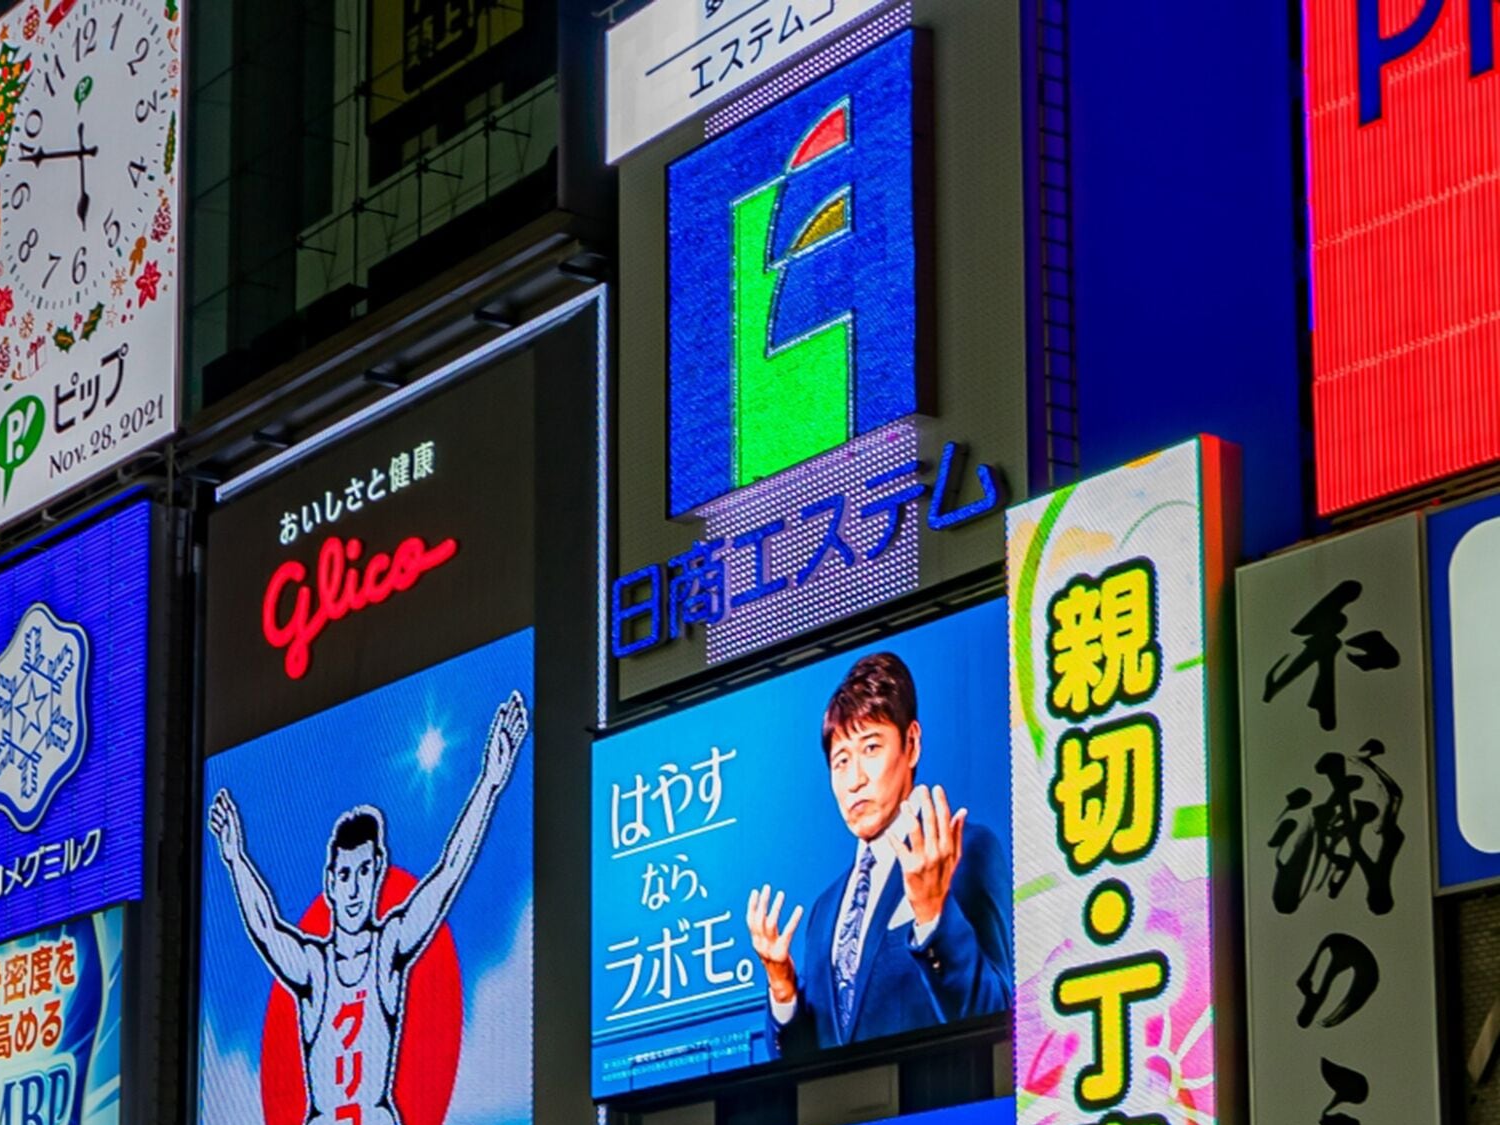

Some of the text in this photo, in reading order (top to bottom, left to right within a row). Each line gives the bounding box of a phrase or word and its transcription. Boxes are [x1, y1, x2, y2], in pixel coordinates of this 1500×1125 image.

[72, 19, 96, 60] 12
[110, 14, 123, 49] 1
[41, 57, 65, 96] 11
[127, 38, 150, 76] 2
[134, 91, 157, 122] 3
[128, 158, 146, 189] 4
[11, 182, 30, 210] 9
[19, 229, 38, 262] 8
[103, 210, 122, 249] 5
[41, 254, 62, 290] 7
[72, 247, 87, 285] 6
[53, 343, 129, 435] ピップ
[49, 396, 166, 476] Nov. 28, 2021
[279, 441, 435, 545] おいしさと健康
[610, 440, 998, 659] 日商エステム
[262, 536, 458, 679] Glico
[611, 746, 737, 849] はやす
[641, 854, 708, 910] なら、
[605, 911, 753, 1009] ラボモ。
